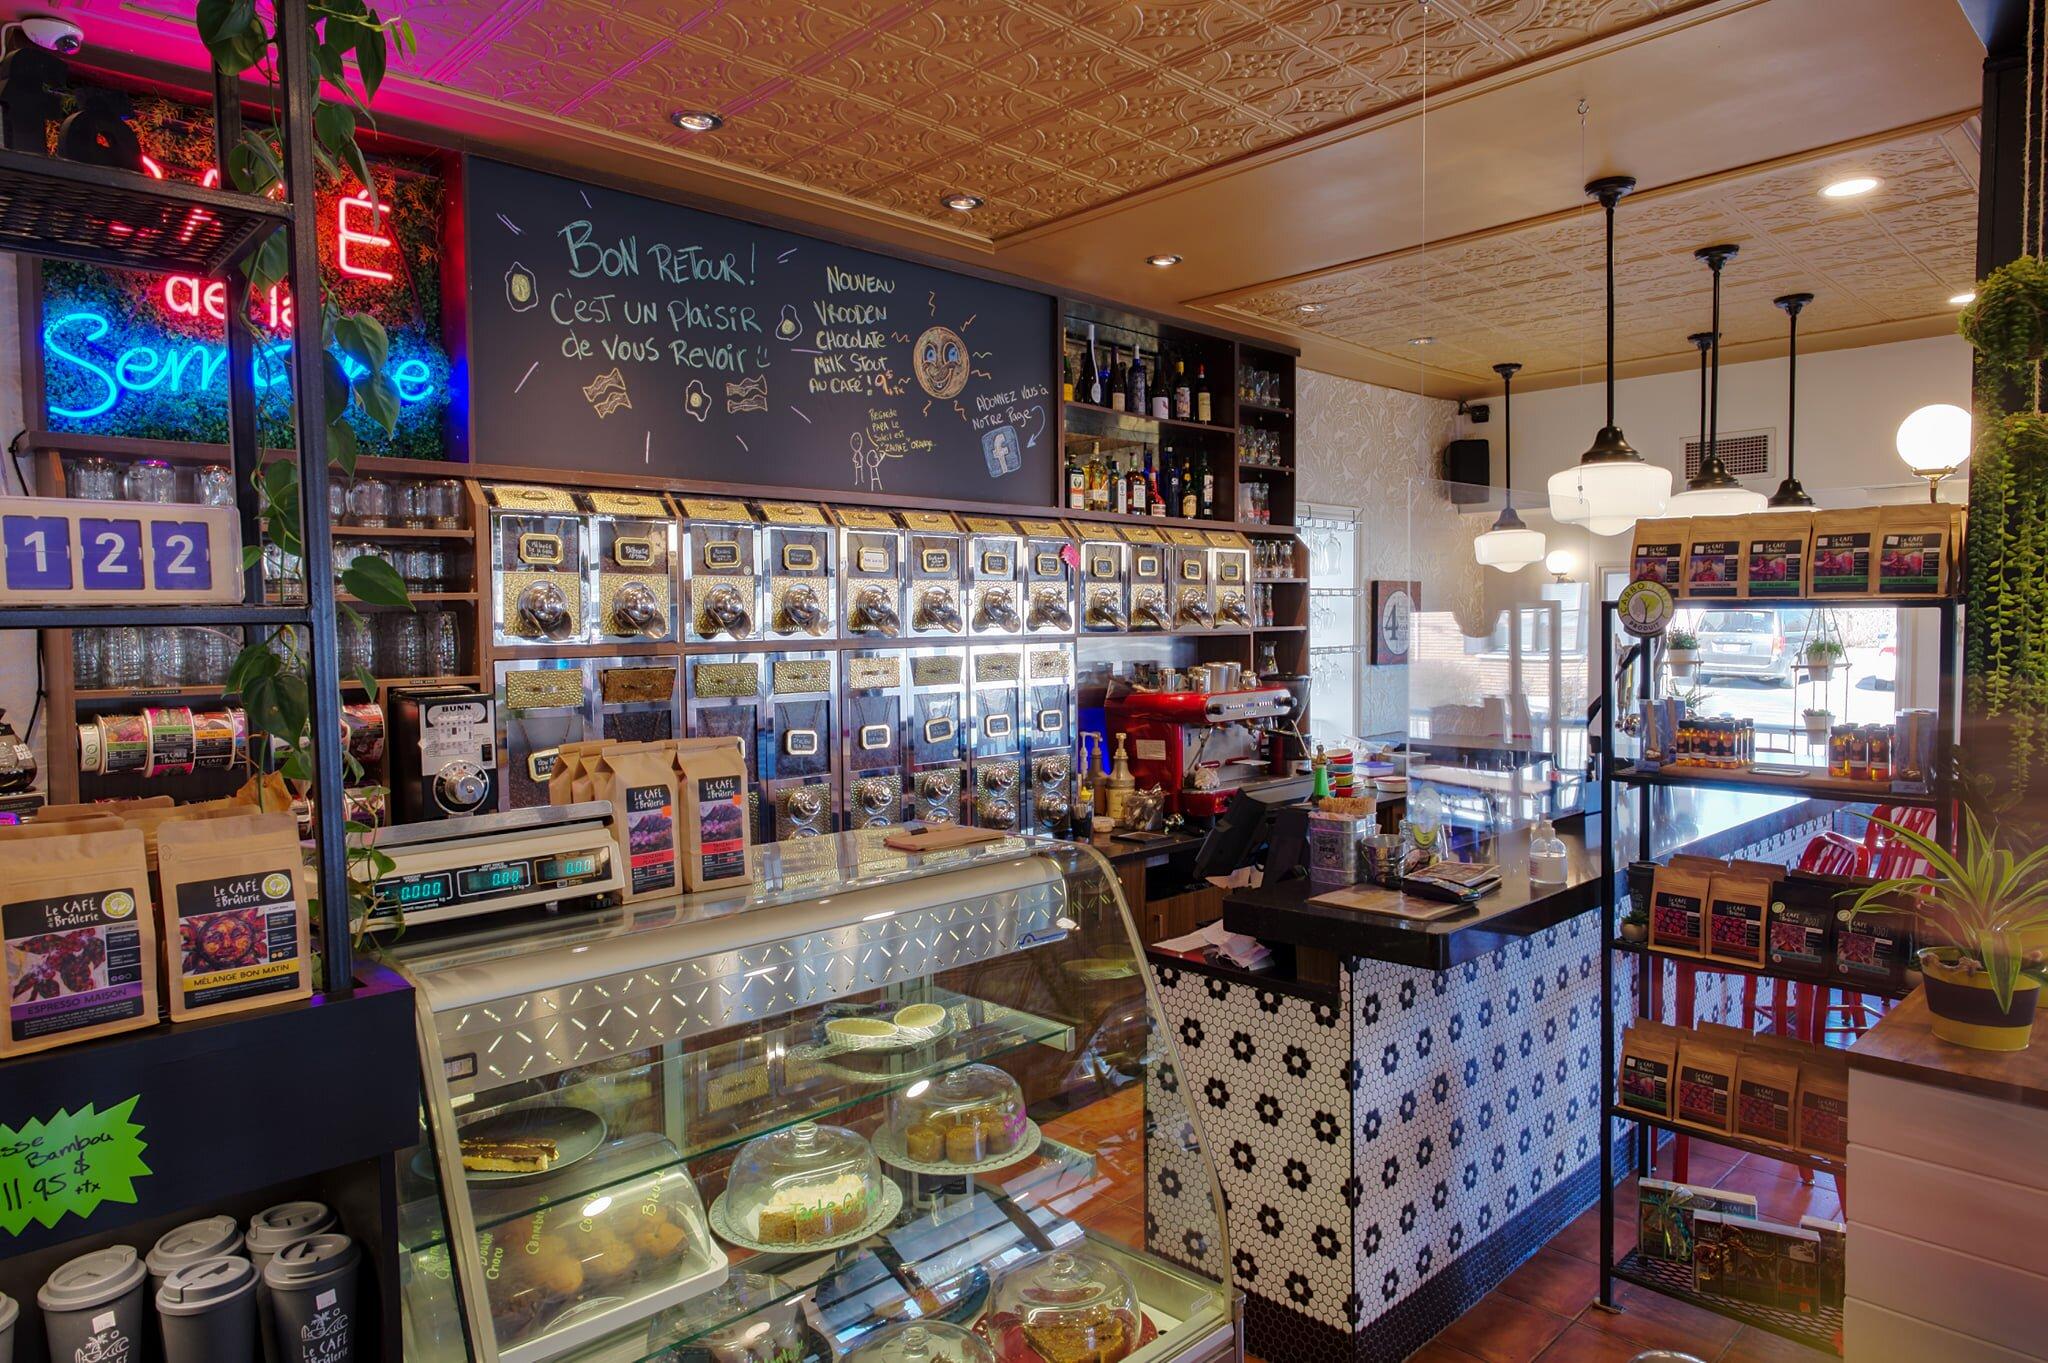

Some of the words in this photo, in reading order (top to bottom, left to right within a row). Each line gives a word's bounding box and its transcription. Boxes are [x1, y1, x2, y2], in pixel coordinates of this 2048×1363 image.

[557, 220, 639, 278] BON
[826, 265, 896, 294] NOUVEAU
[624, 301, 658, 325] UN
[562, 329, 594, 360] de
[1629, 620, 1660, 631] PRODUIT
[441, 704, 473, 713] BUNN
[634, 791, 642, 801] Le
[644, 788, 664, 800] CAFÉ
[706, 781, 715, 791] Le
[715, 778, 734, 789] CAFÉ
[213, 885, 225, 897] Le
[229, 878, 259, 894] CAFÉ
[492, 870, 519, 886] 0.00
[221, 893, 261, 907] Brûlerie
[401, 882, 441, 900] 0.000
[45, 905, 59, 918] Le
[62, 897, 99, 914] CAFÉ
[54, 912, 99, 928] Brûlerie
[194, 973, 237, 986] MÉLANGE
[240, 968, 260, 979] BON
[262, 963, 290, 975] MATIN
[27, 1000, 81, 1015] ESPRESSO
[84, 988, 127, 1007] MAISON
[25, 1132, 114, 1168] Bambou
[3, 1172, 67, 1211] 11.95
[303, 1345, 315, 1358] Le
[320, 1329, 348, 1354] CAFÉ
